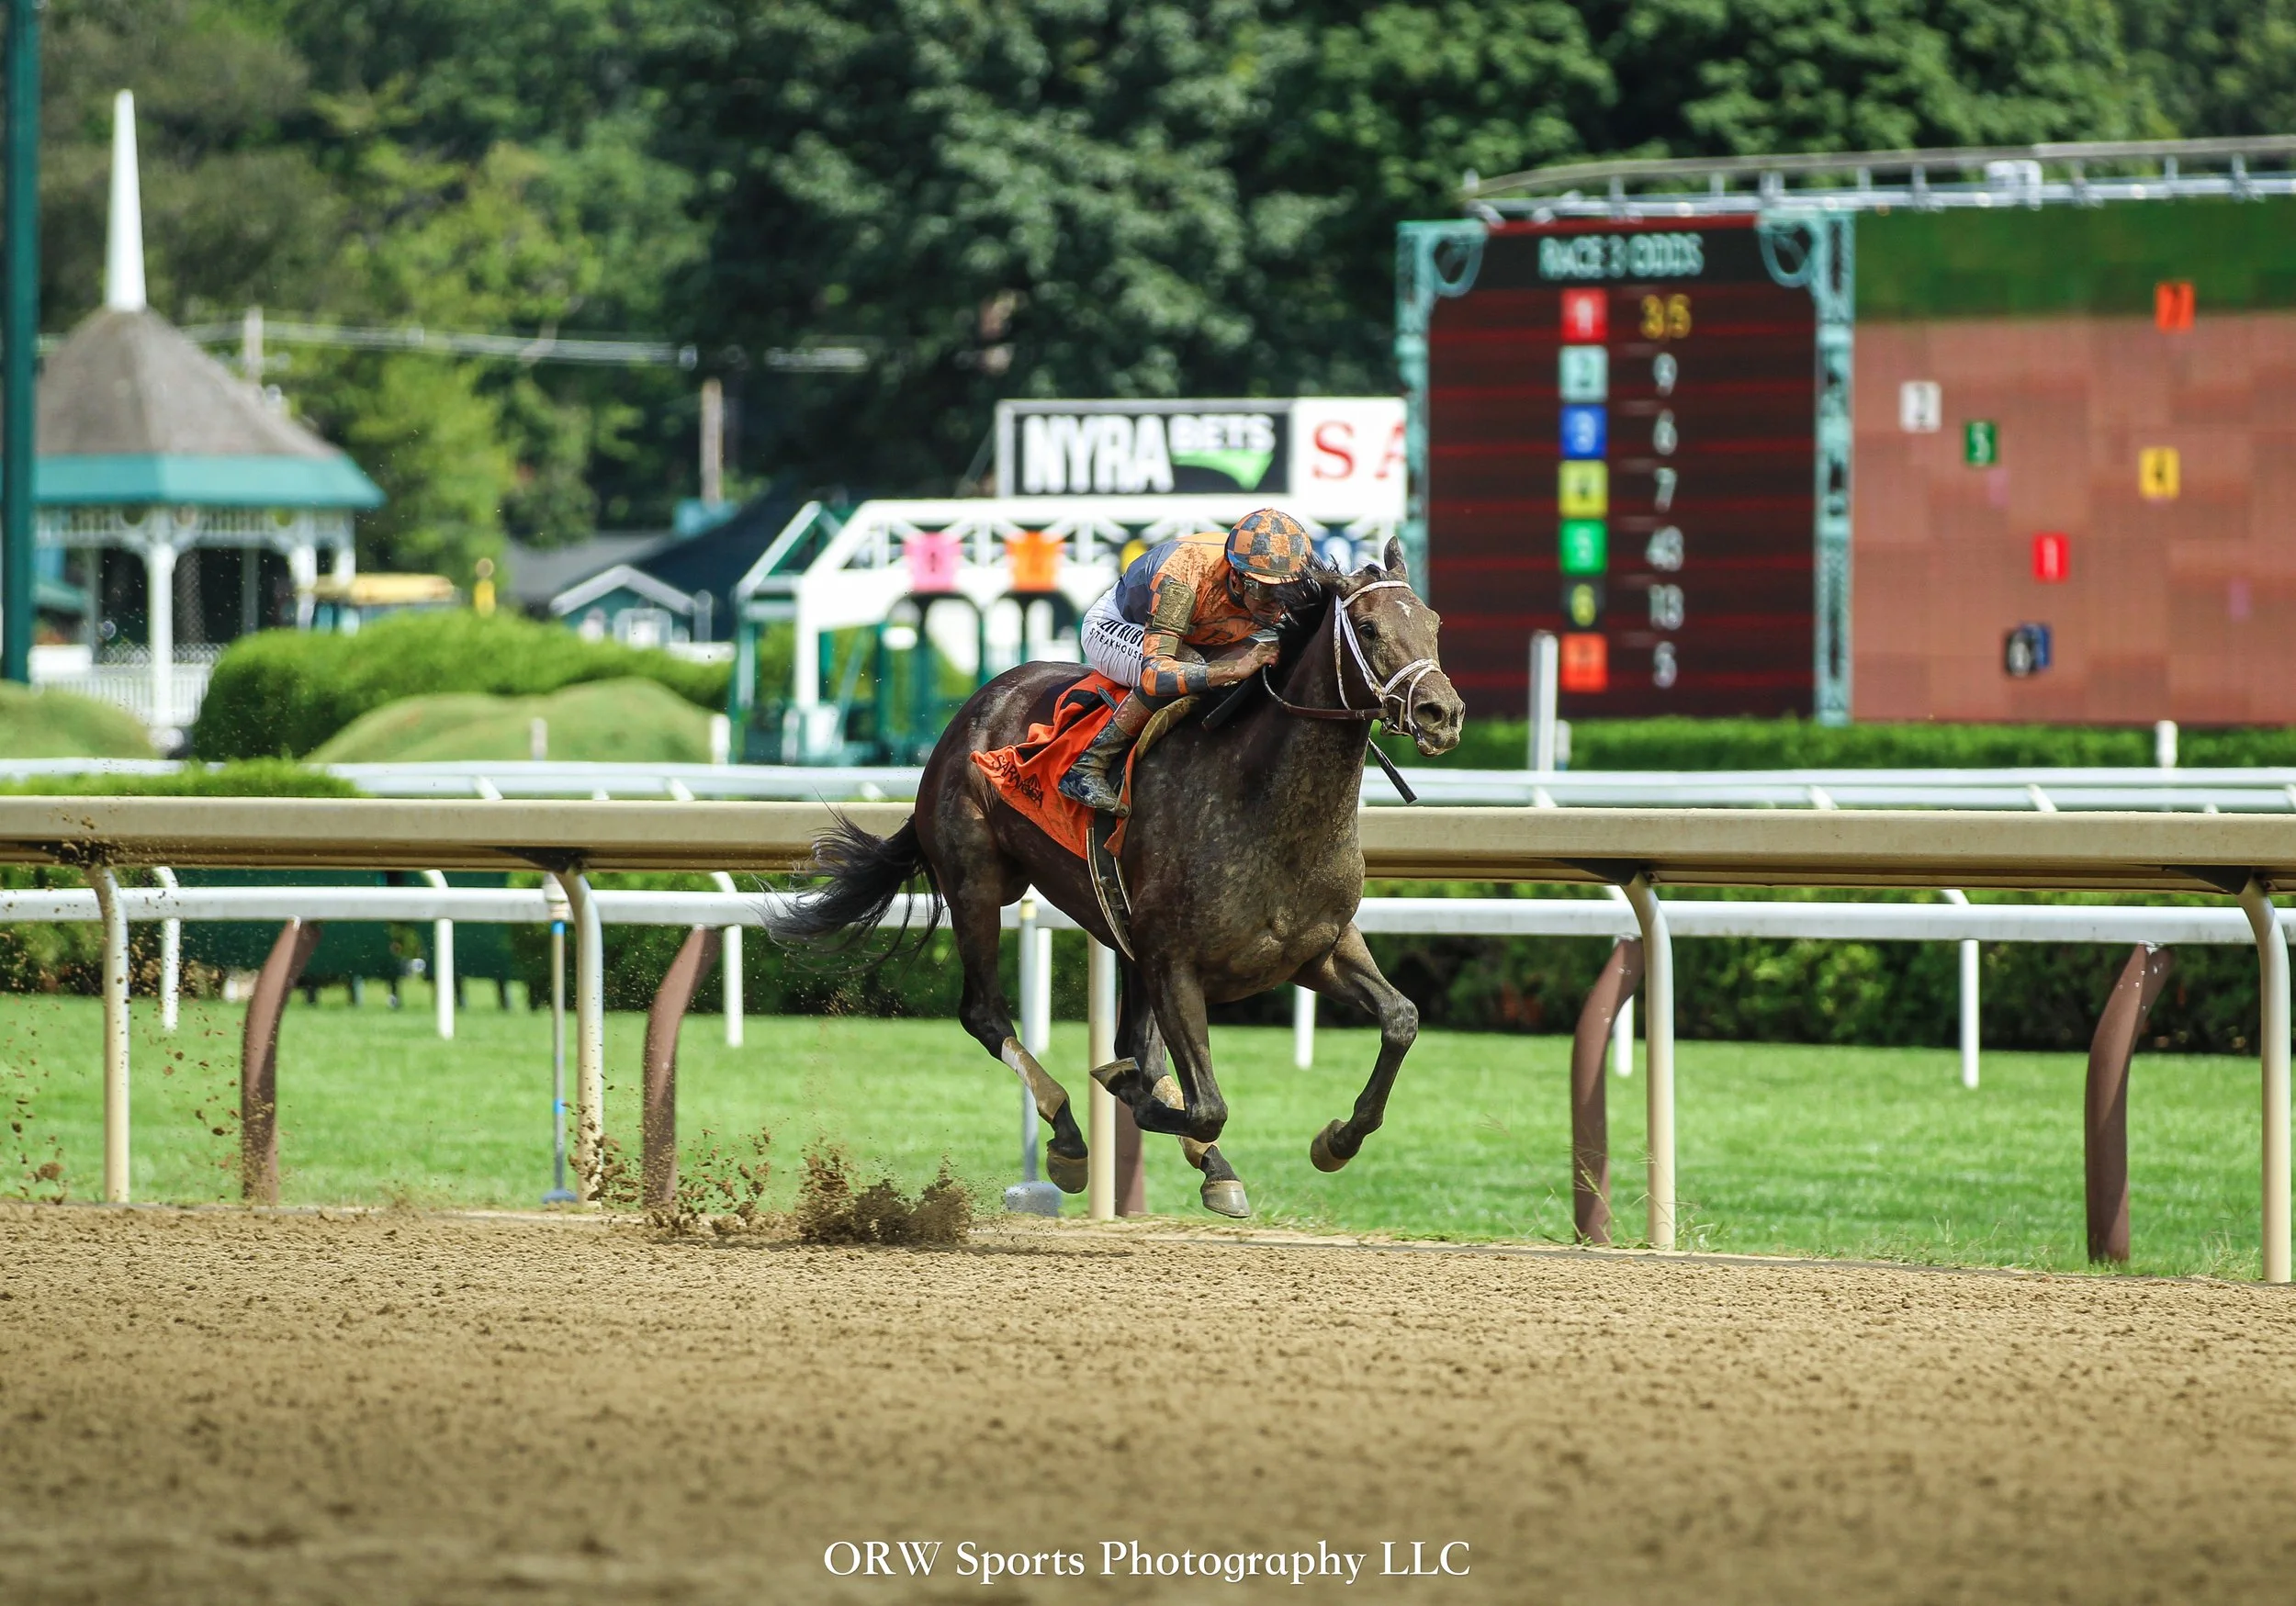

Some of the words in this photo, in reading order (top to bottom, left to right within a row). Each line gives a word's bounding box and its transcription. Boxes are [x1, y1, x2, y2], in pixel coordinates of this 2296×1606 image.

[1538, 235, 1606, 280] RACE
[1607, 234, 1627, 279] 3
[1628, 232, 1705, 277] ODDS
[1023, 413, 1176, 494] NYRA
[1168, 413, 1277, 452] BETS
[1654, 466, 1679, 514] 7
[2042, 536, 2059, 581] 1
[1571, 583, 1596, 627] 6
[1089, 627, 1143, 661] STEAKHOUSE
[1653, 640, 1678, 689] 5
